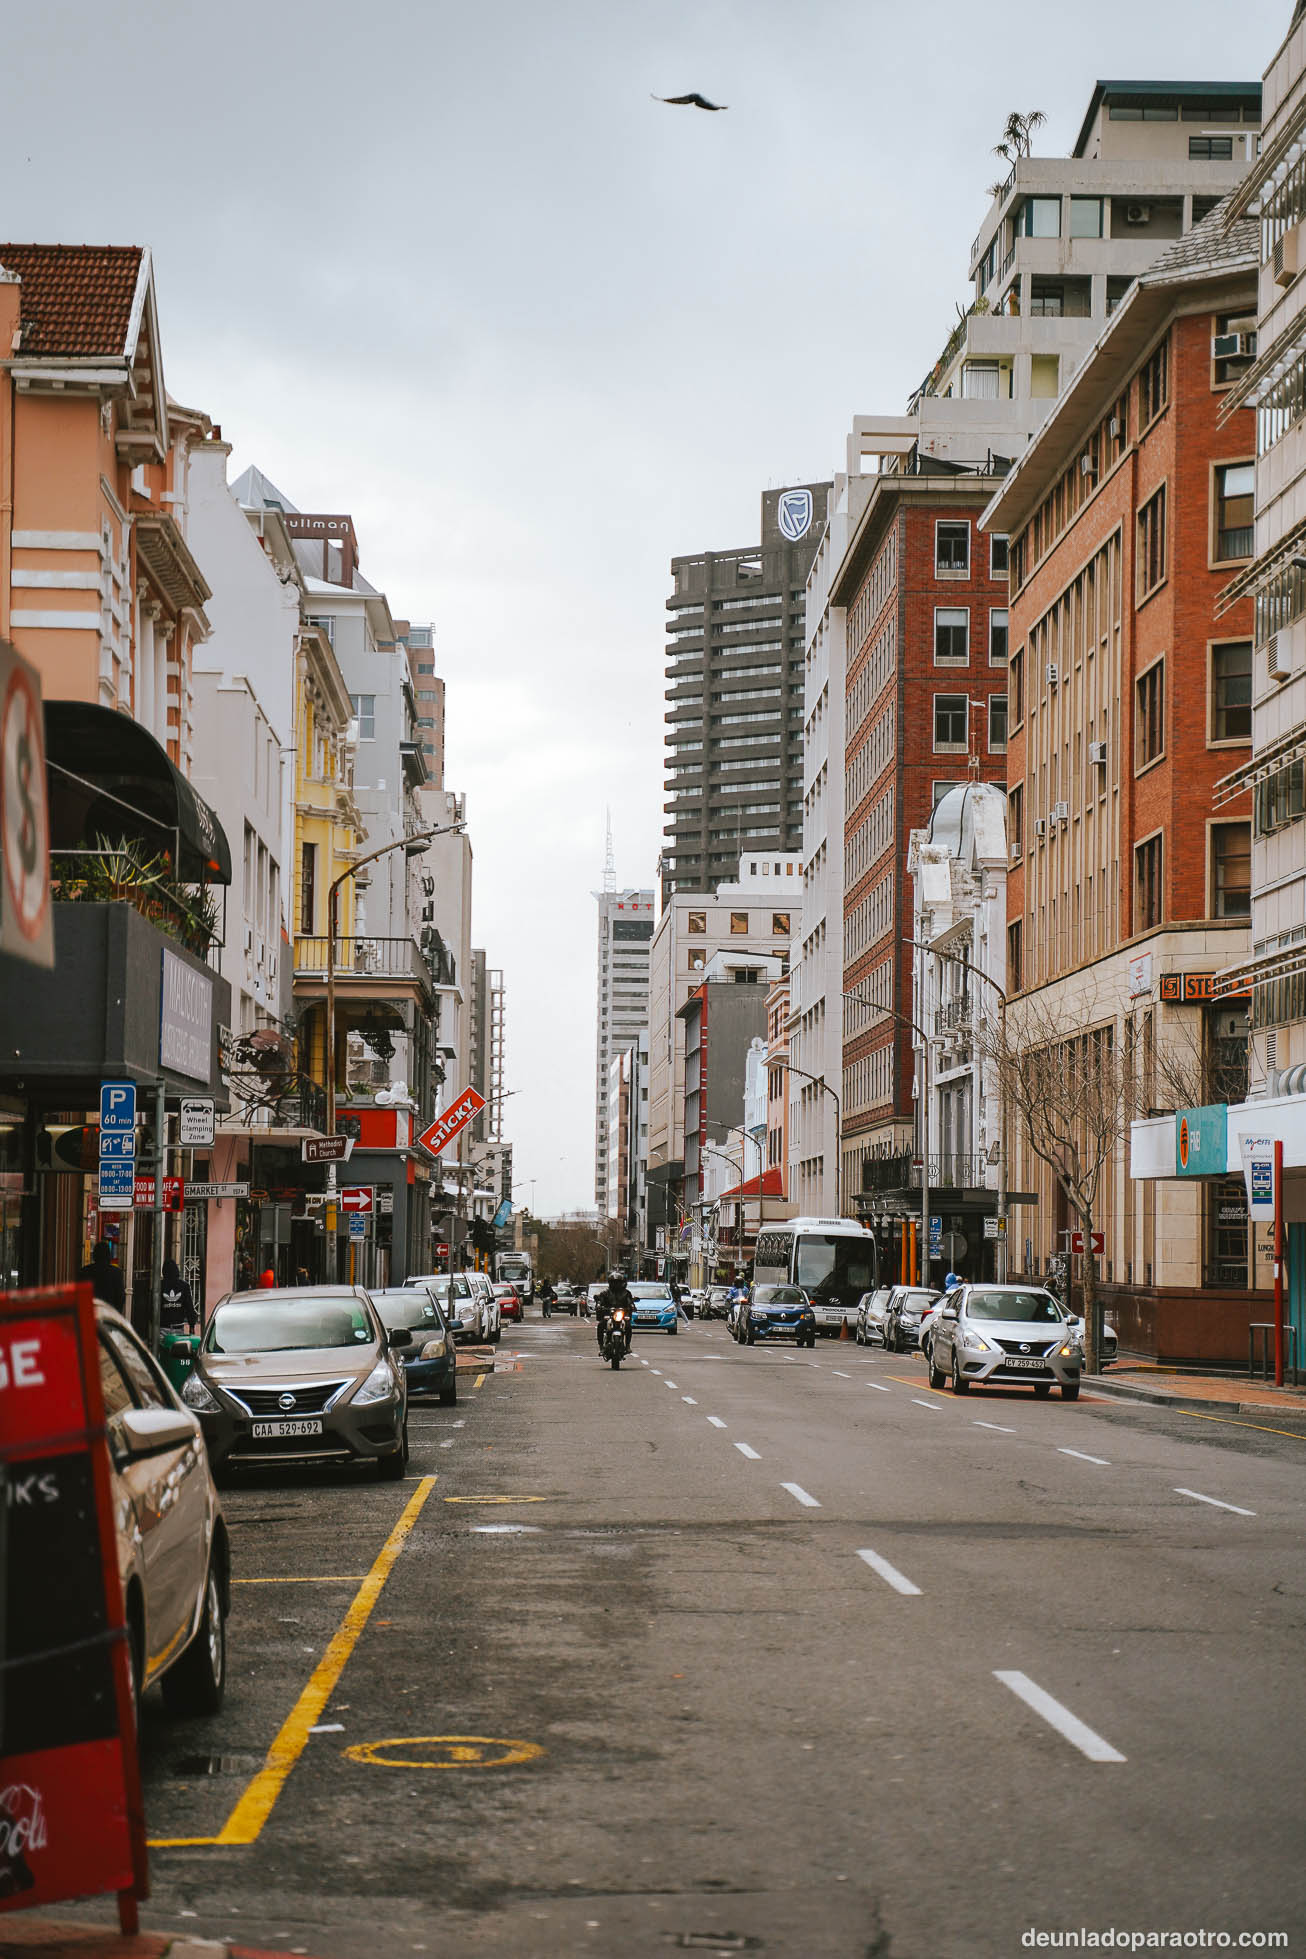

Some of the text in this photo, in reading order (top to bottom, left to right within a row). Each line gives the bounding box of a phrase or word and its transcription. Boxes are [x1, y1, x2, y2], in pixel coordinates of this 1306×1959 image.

[109, 1089, 127, 1110] P
[104, 1114, 132, 1125] 60 min
[181, 1125, 213, 1133] Clamping
[318, 1139, 343, 1149] Methodist
[319, 1149, 337, 1157] Church
[184, 1186, 219, 1196] GMARKET
[254, 1424, 273, 1437] CAA
